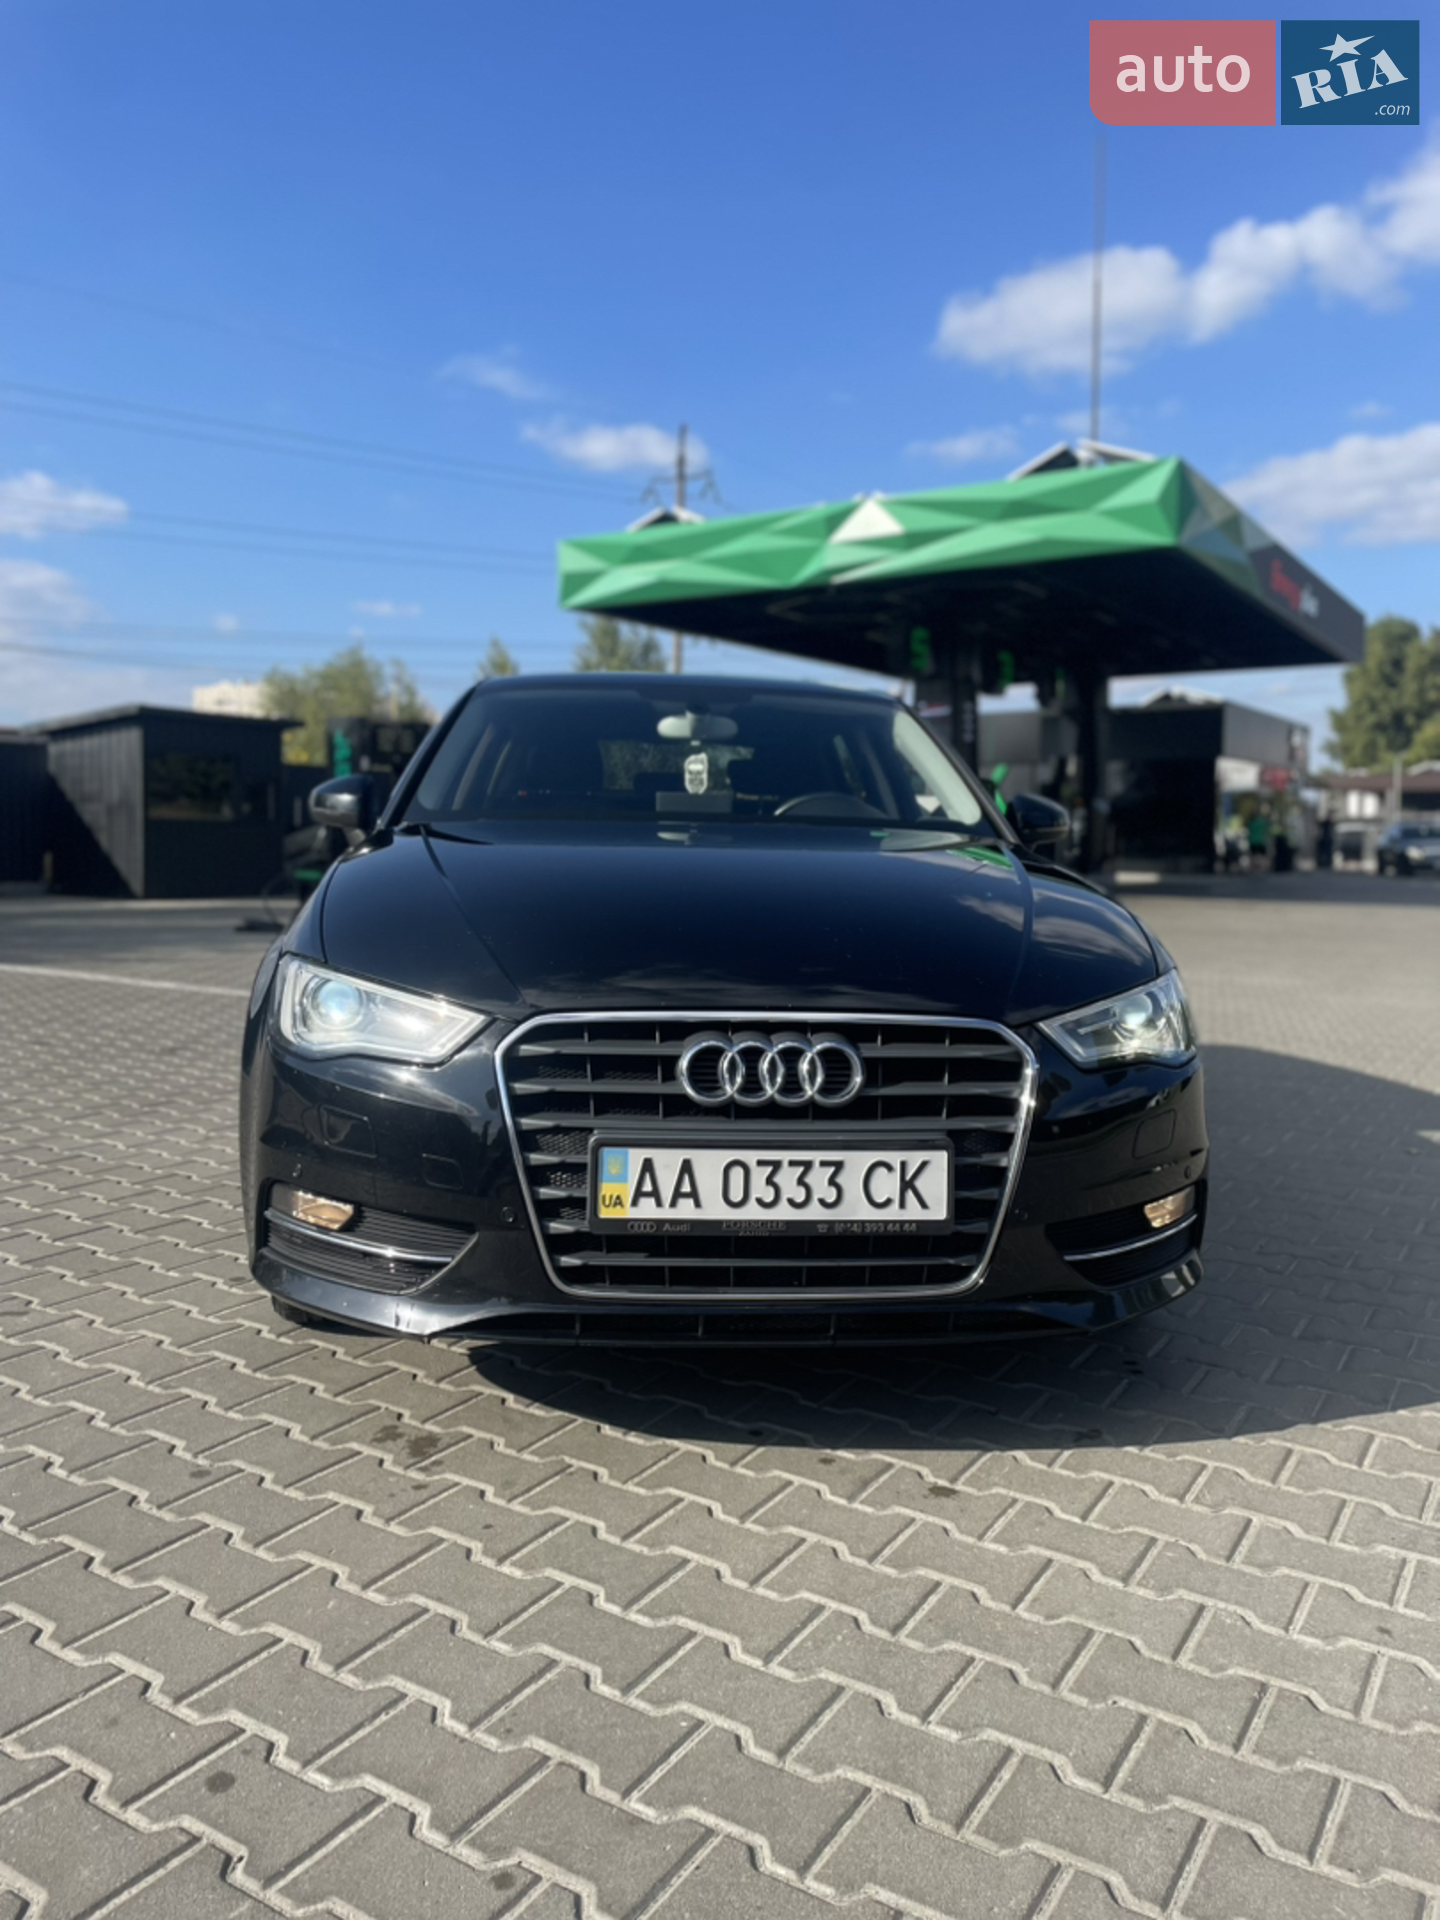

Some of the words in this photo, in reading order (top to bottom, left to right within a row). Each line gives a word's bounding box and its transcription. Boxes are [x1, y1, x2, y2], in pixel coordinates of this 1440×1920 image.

[630, 1157, 702, 1208] AA
[721, 1159, 844, 1210] 0333
[861, 1160, 931, 1210] CK
[602, 1194, 624, 1208] UA
[663, 1222, 690, 1232] Audi
